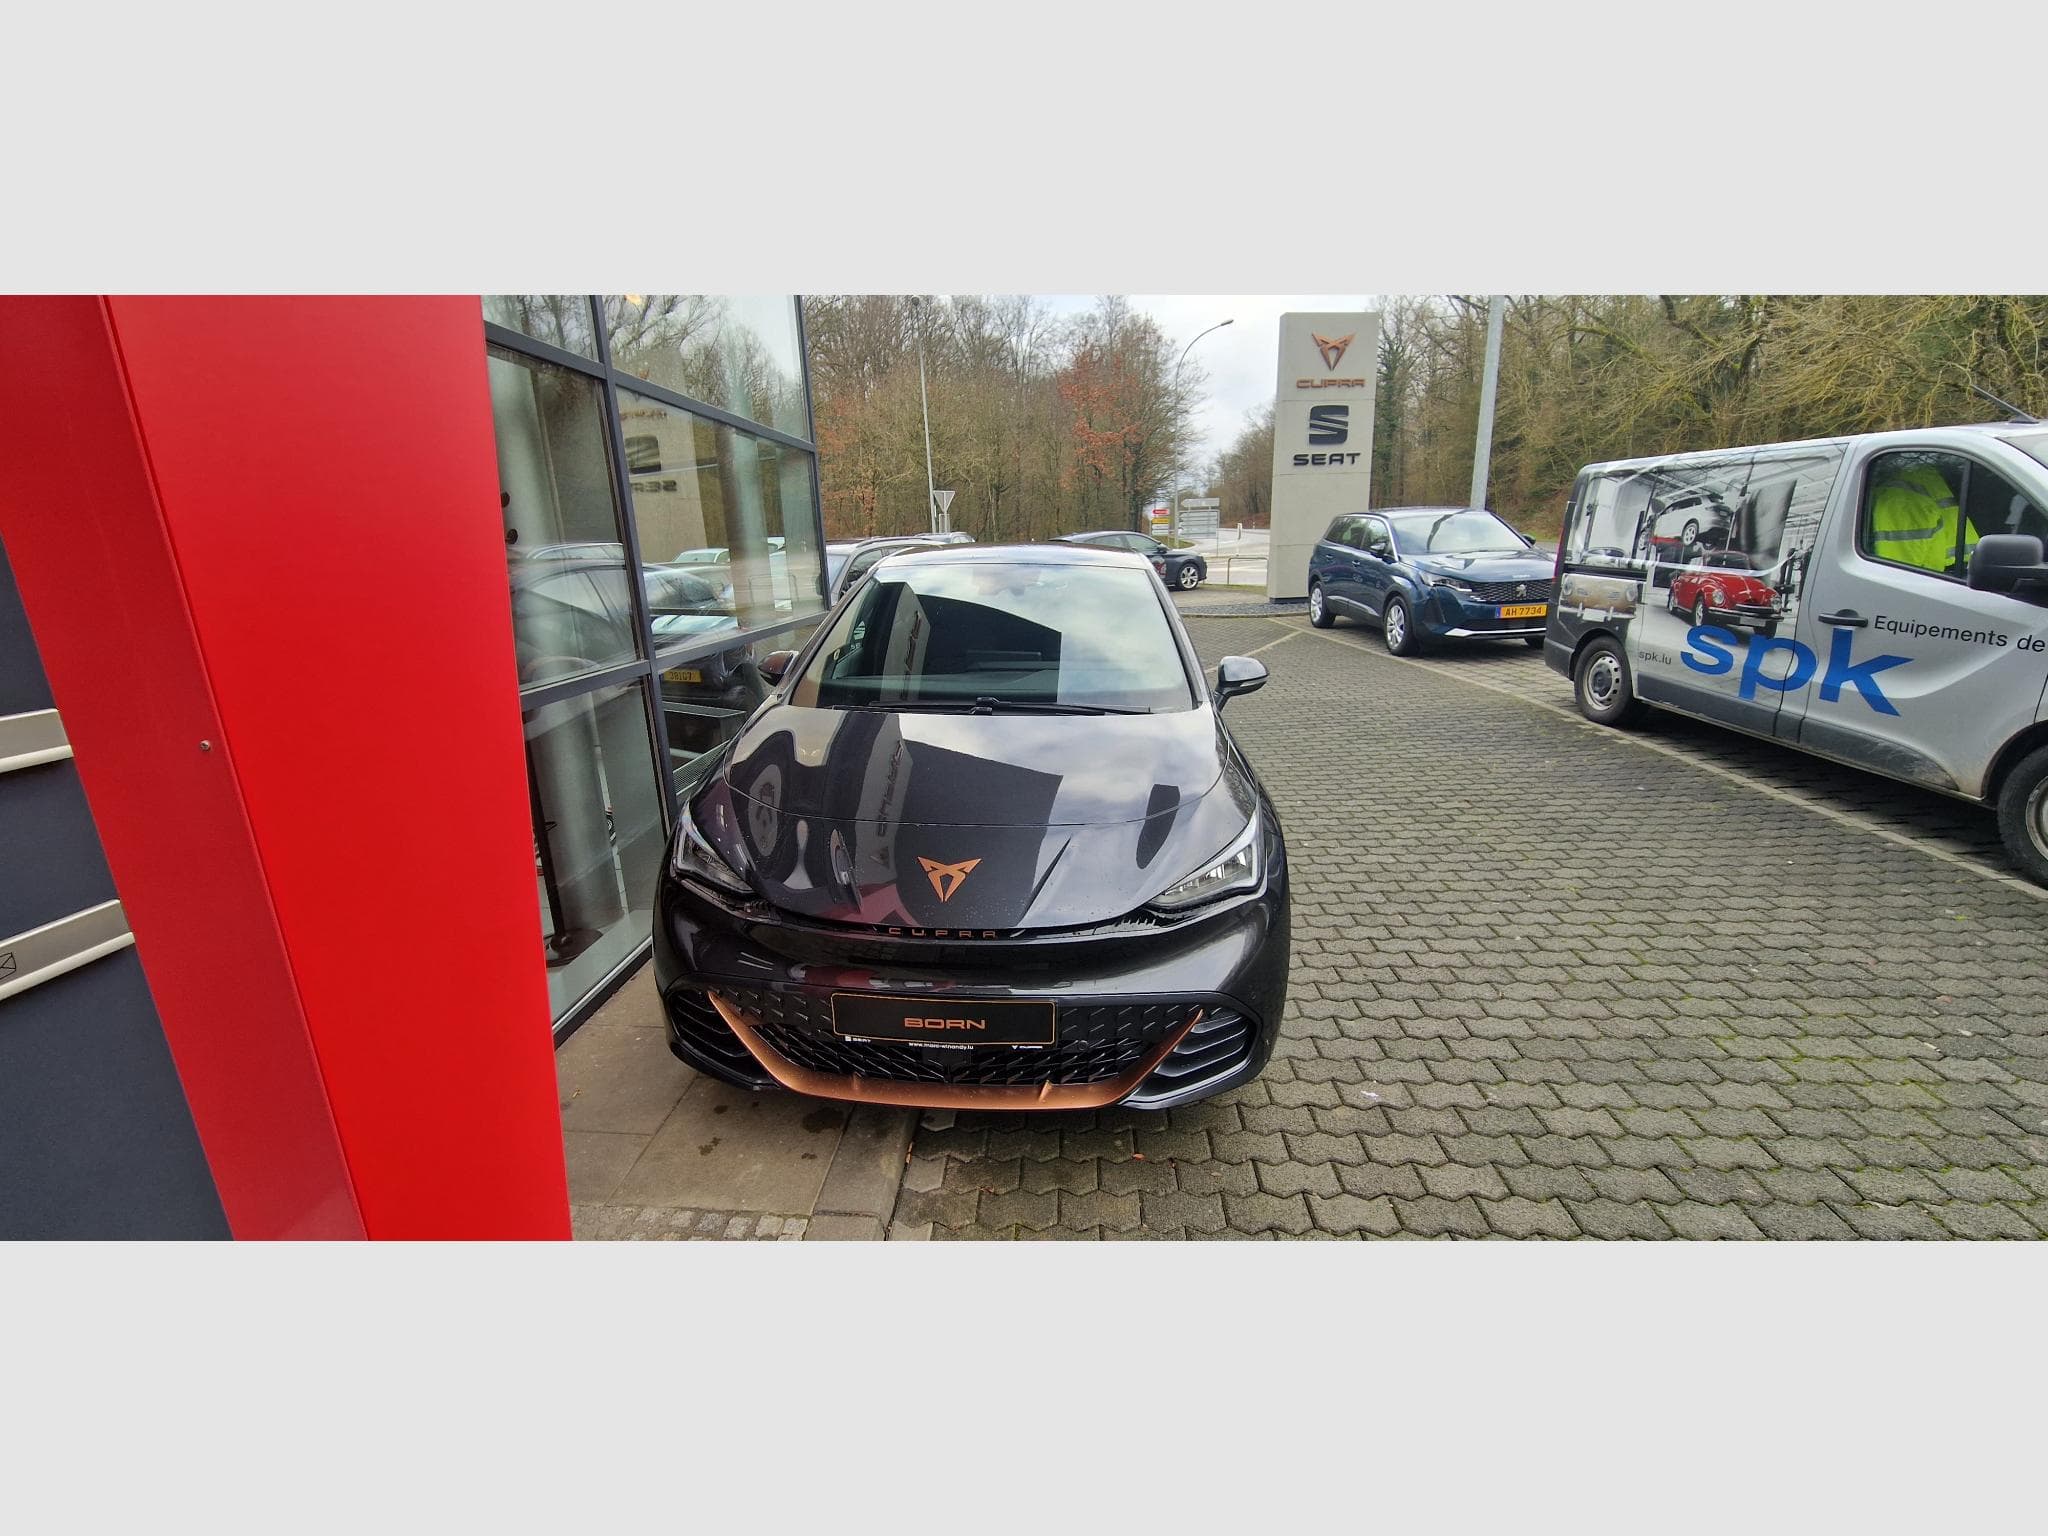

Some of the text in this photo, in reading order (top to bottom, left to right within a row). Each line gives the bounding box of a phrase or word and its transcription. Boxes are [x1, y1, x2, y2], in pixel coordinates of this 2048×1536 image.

[1296, 378, 1366, 389] CUPRA
[1293, 453, 1361, 466] SEAT
[1505, 607, 1517, 616] AH
[1520, 606, 1542, 616] 7734
[1874, 615, 2046, 652] Equipements de
[1639, 651, 1672, 665] spk.lu
[1680, 624, 1914, 717] spk
[888, 927, 996, 939] CUPRA
[904, 1017, 986, 1030] BORN
